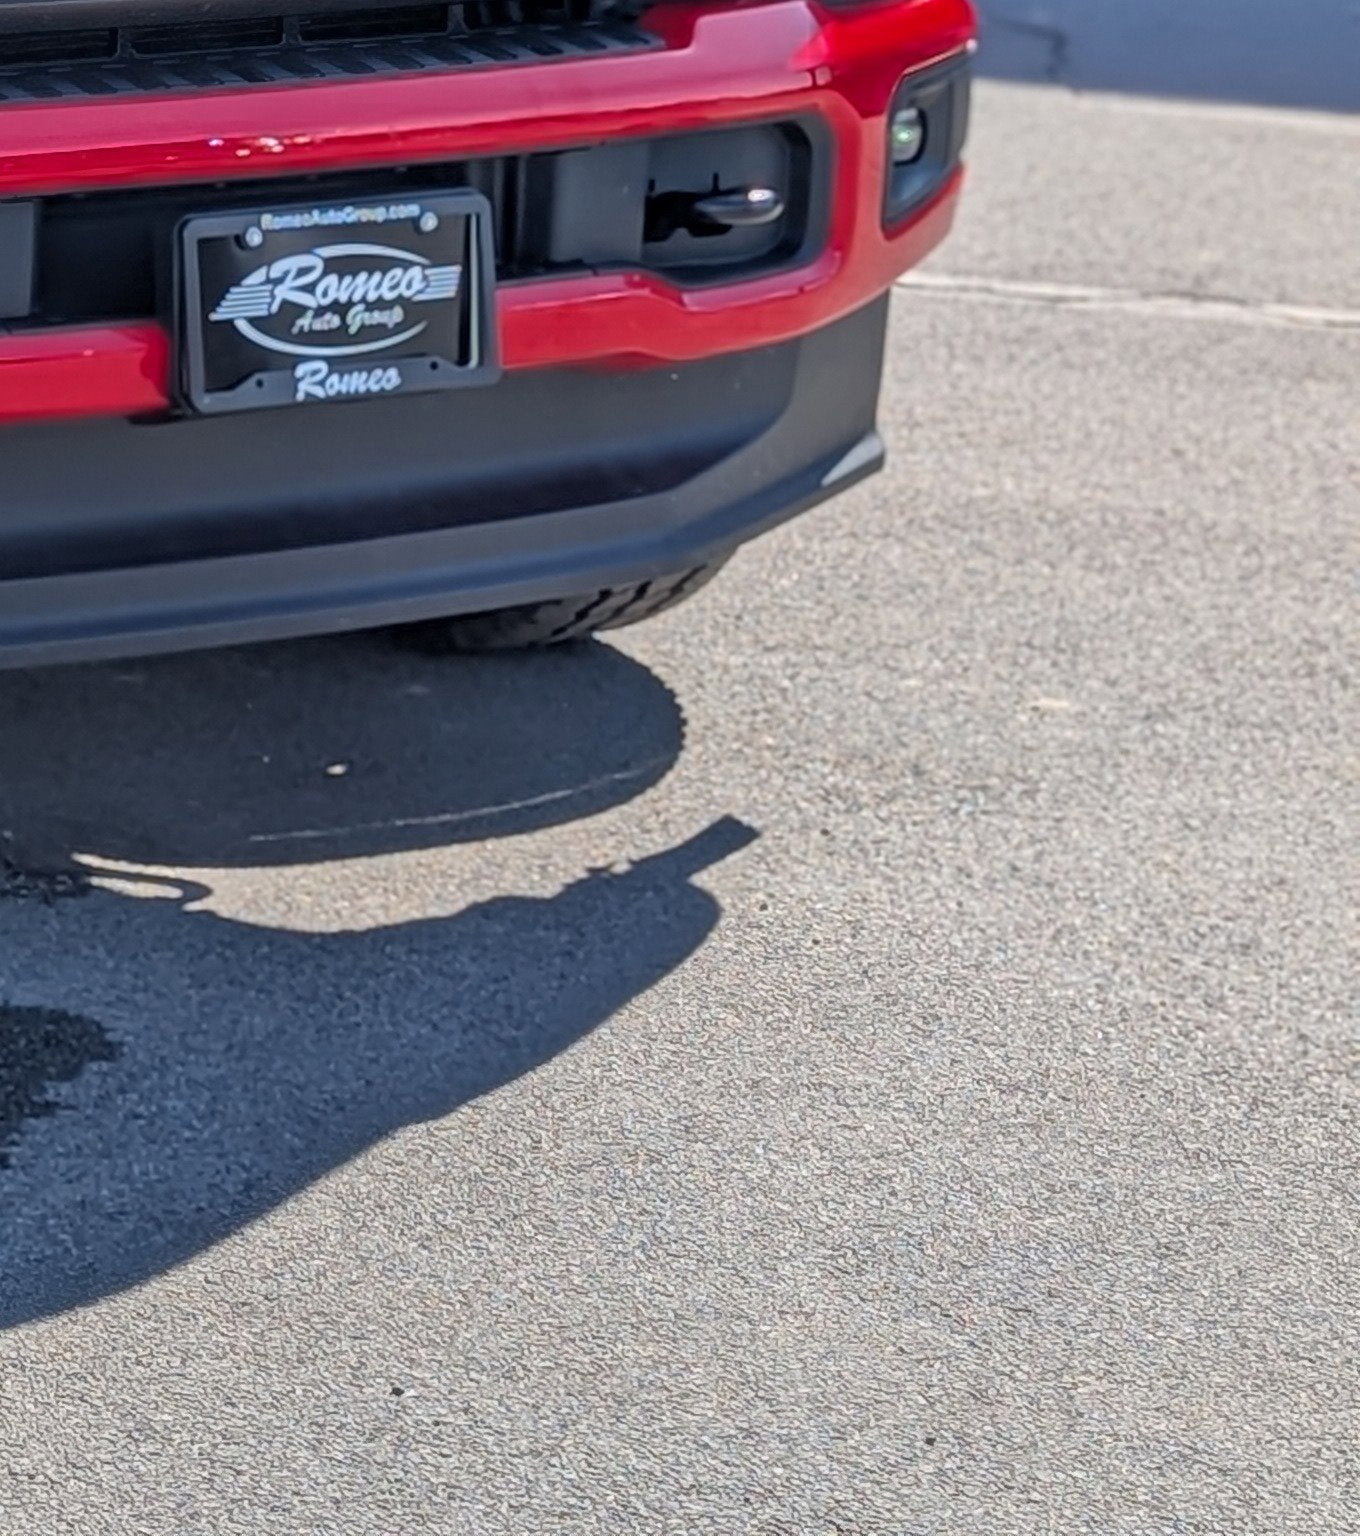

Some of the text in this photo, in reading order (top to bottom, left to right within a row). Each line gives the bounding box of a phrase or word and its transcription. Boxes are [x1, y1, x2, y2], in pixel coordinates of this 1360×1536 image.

[267, 253, 430, 315] Romeo
[290, 303, 405, 335] Auto Group
[293, 359, 402, 402] Romeo
